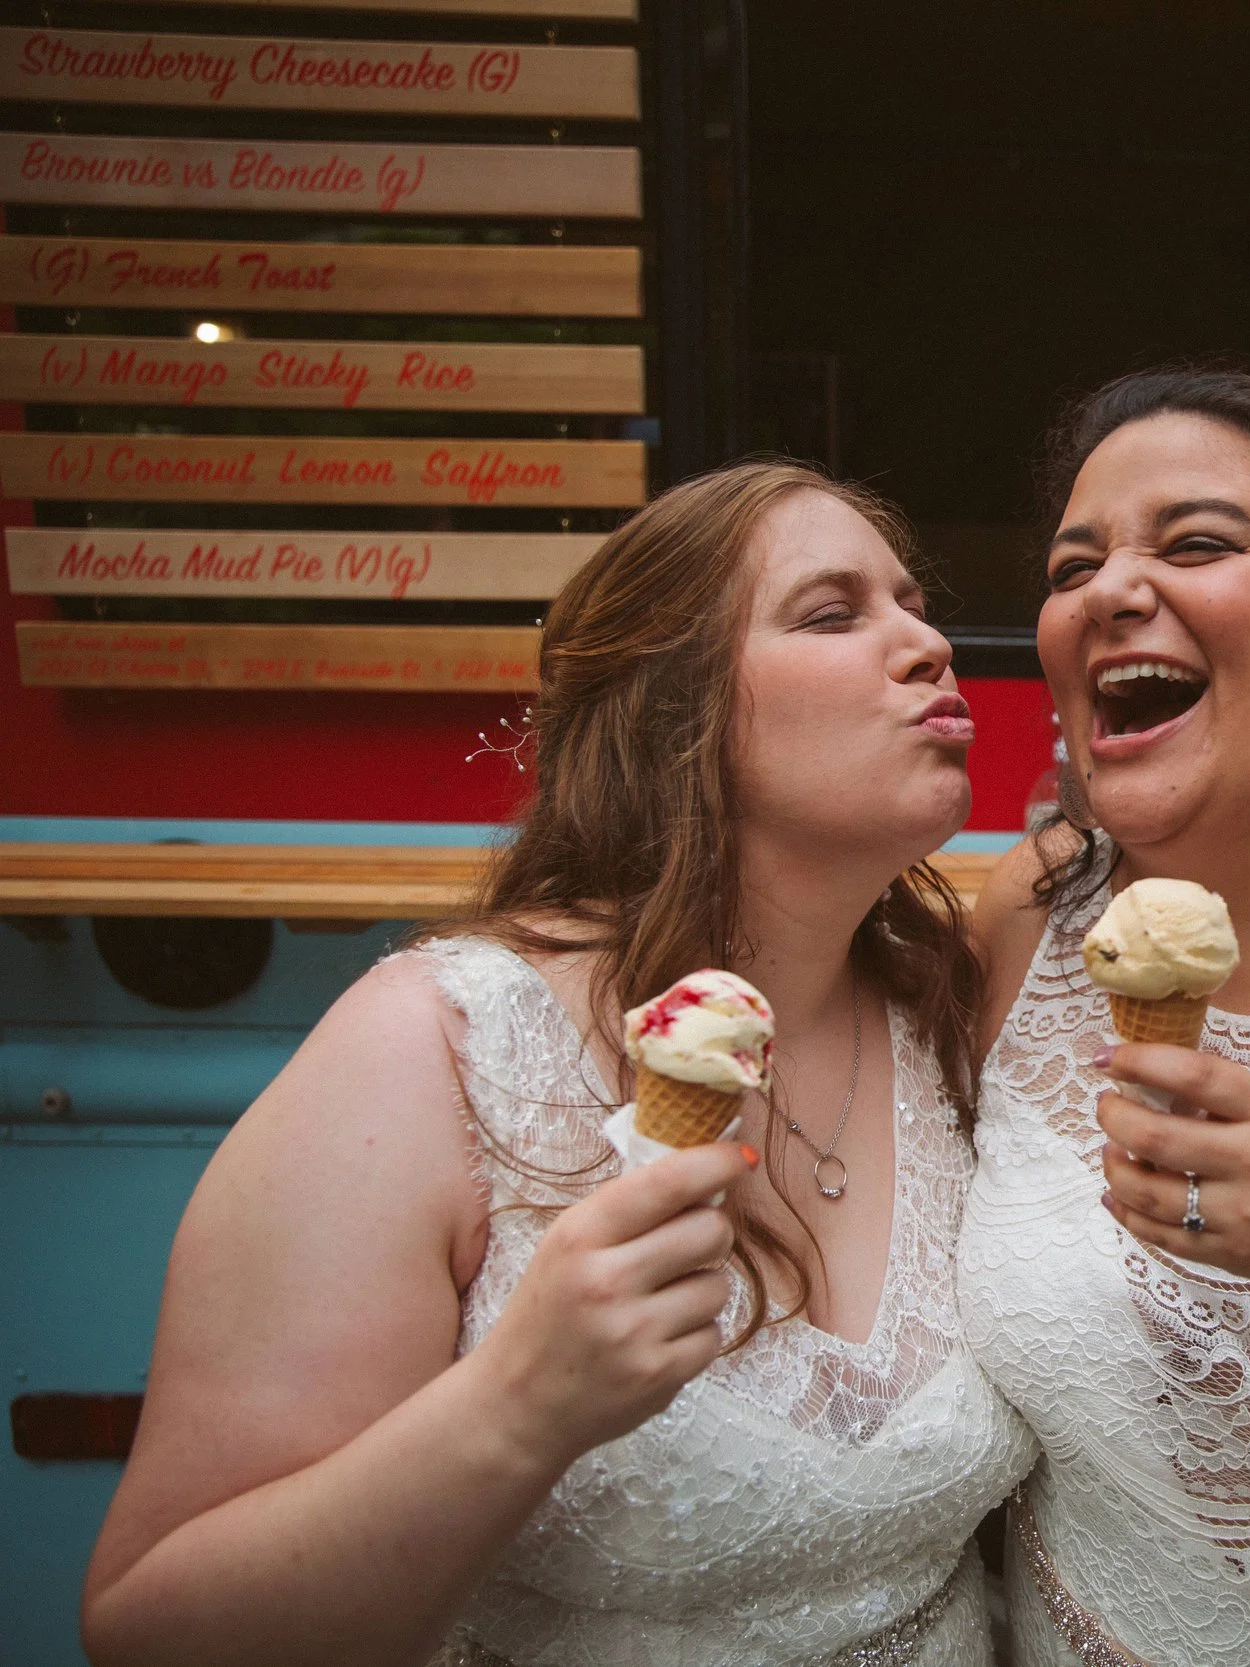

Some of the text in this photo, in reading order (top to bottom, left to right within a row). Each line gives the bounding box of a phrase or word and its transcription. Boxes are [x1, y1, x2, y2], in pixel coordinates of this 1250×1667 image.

[18, 33, 521, 100] Strawberry Cheesecake (G)
[21, 140, 426, 213] Brownie vs Blondie (g)
[28, 247, 336, 293] (G) French Toast
[100, 350, 228, 406] Mango
[255, 349, 372, 408] Sticky
[398, 351, 476, 393] Rice
[106, 445, 257, 487] Coconut
[279, 448, 397, 487] Lemon
[421, 448, 565, 501] Saffron
[58, 541, 173, 581] Mocha
[181, 543, 261, 582] Mud
[269, 544, 325, 582] Pie
